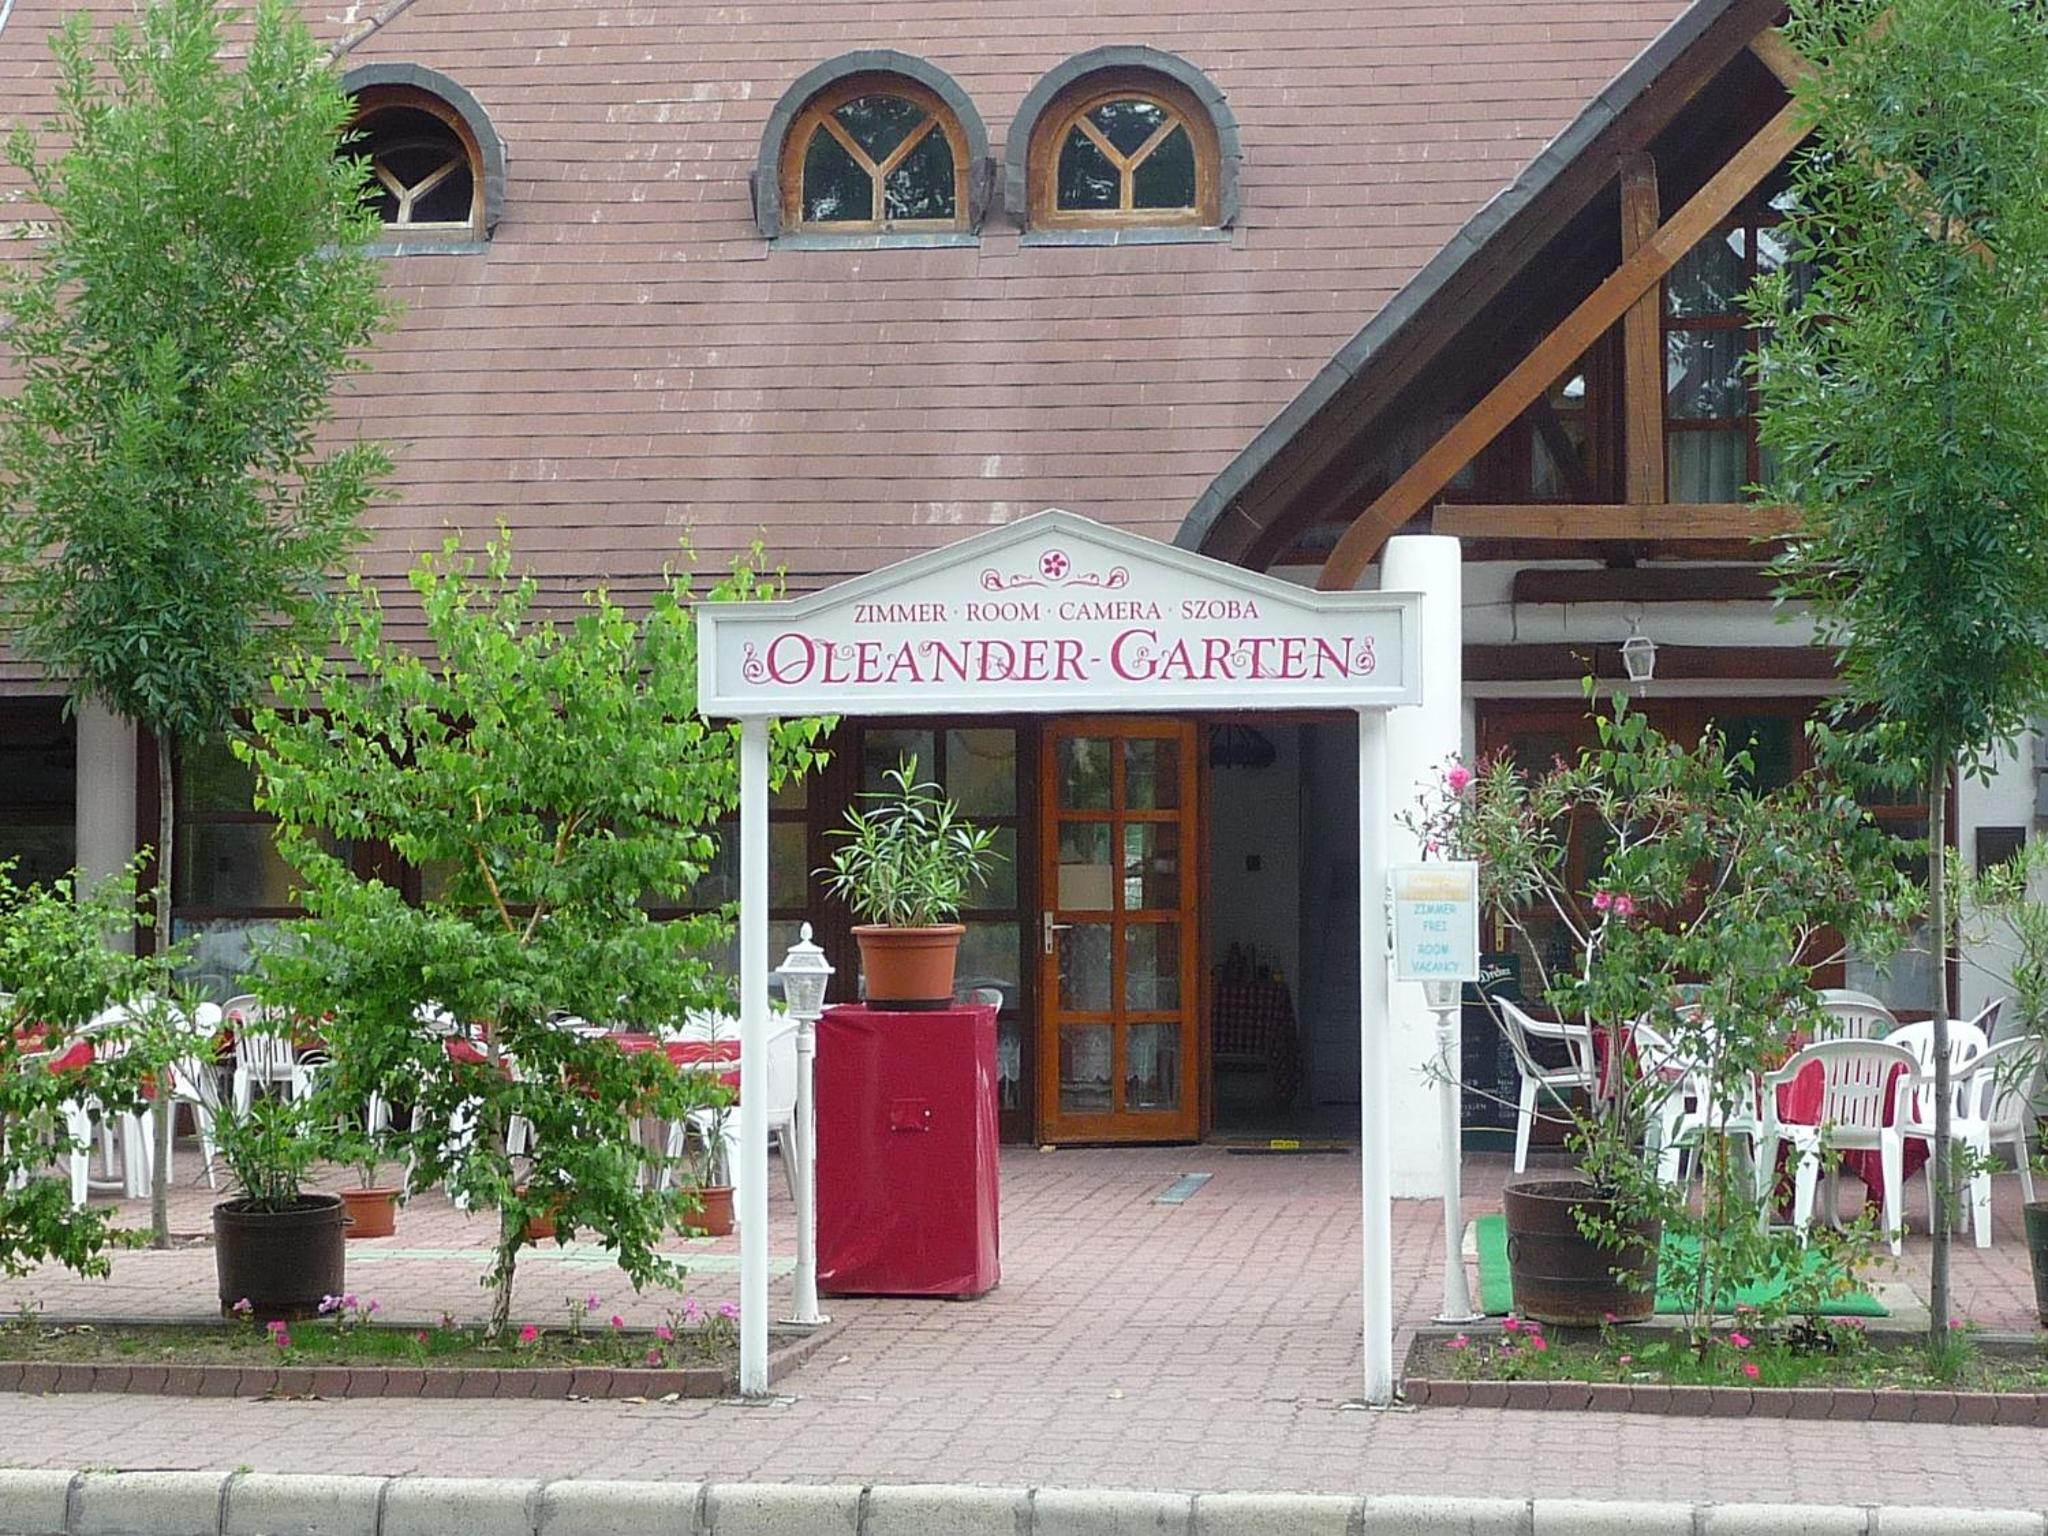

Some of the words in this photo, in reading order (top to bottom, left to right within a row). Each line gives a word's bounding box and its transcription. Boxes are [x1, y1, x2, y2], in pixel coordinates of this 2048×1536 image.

[854, 603, 947, 623] ZIMMER
[967, 602, 1040, 622] ROOM
[1059, 600, 1162, 621] CAMERA
[1182, 599, 1260, 620] SZOBA
[743, 629, 1376, 685] OLEANDER-GARTEN
[1414, 903, 1457, 915] ZIMMER
[1423, 919, 1448, 932] FREI
[1417, 943, 1450, 955] ROOM
[1410, 960, 1459, 973] VACANCY
